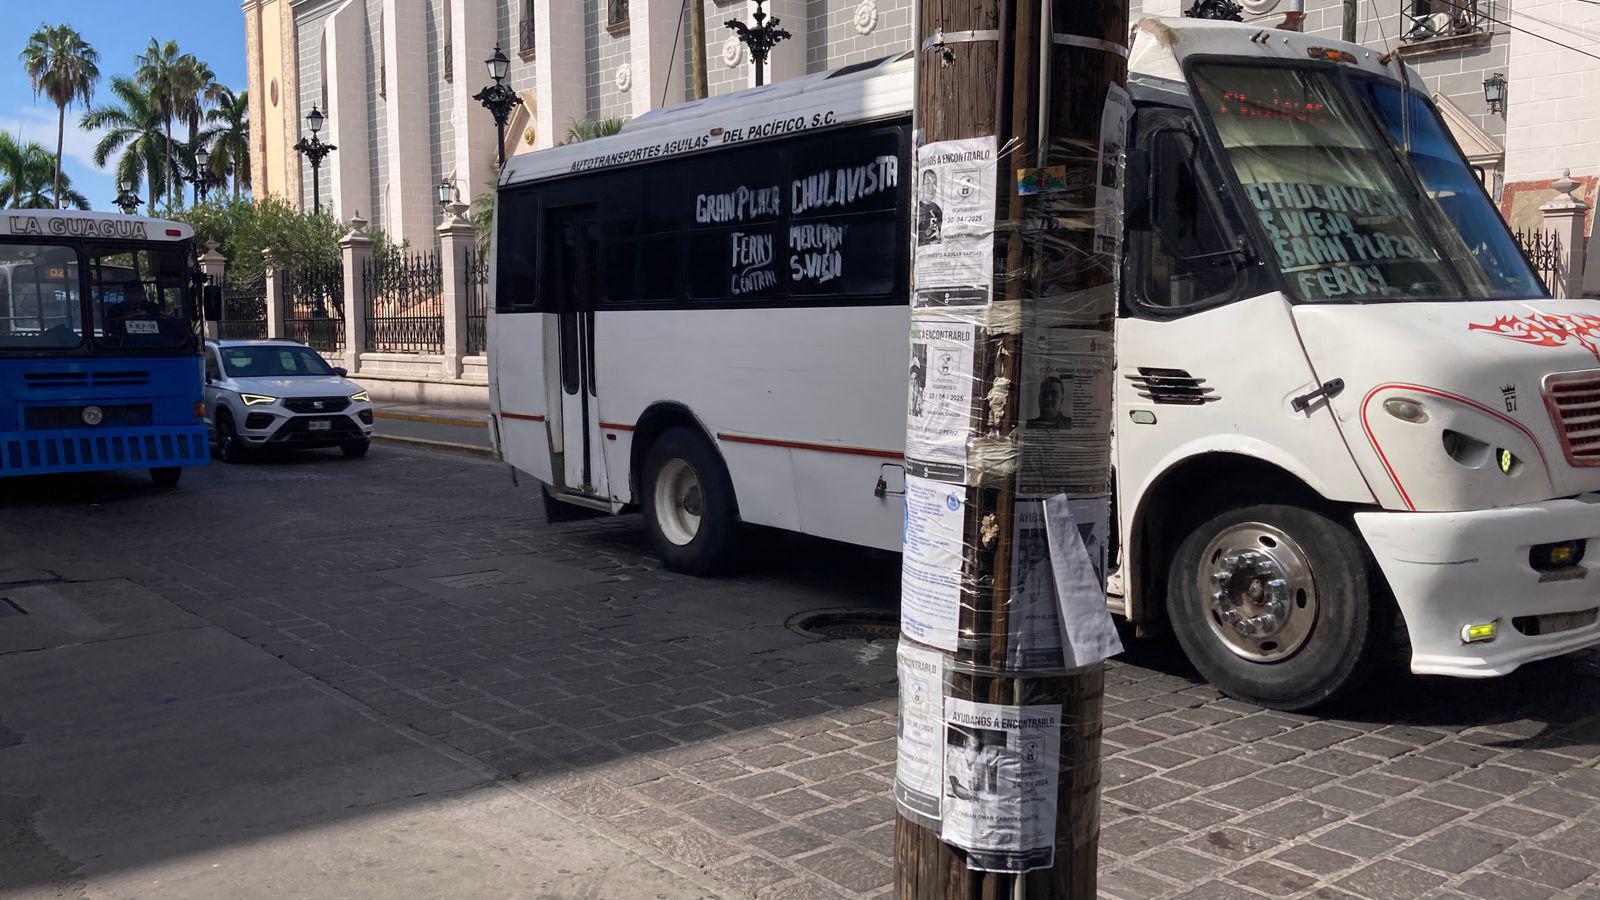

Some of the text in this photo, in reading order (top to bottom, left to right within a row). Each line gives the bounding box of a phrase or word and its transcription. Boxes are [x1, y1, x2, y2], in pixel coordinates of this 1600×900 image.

[570, 144, 661, 172] AUTOTRANSPORTES
[662, 135, 709, 155] AGUILAS
[723, 128, 744, 143] DEL
[811, 111, 837, 127] S.C.
[943, 150, 990, 165] ENCONTRARLO
[696, 192, 737, 223] GRAN
[9, 216, 149, 239] LA GUAGUA
[731, 232, 775, 271] FERRY
[1346, 231, 1424, 261] PLAZA
[1297, 264, 1391, 301] FERRY
[926, 329, 971, 341] ENCONTRARLO
[952, 711, 1055, 730] AYUDANOS A ENCONTRARLO
